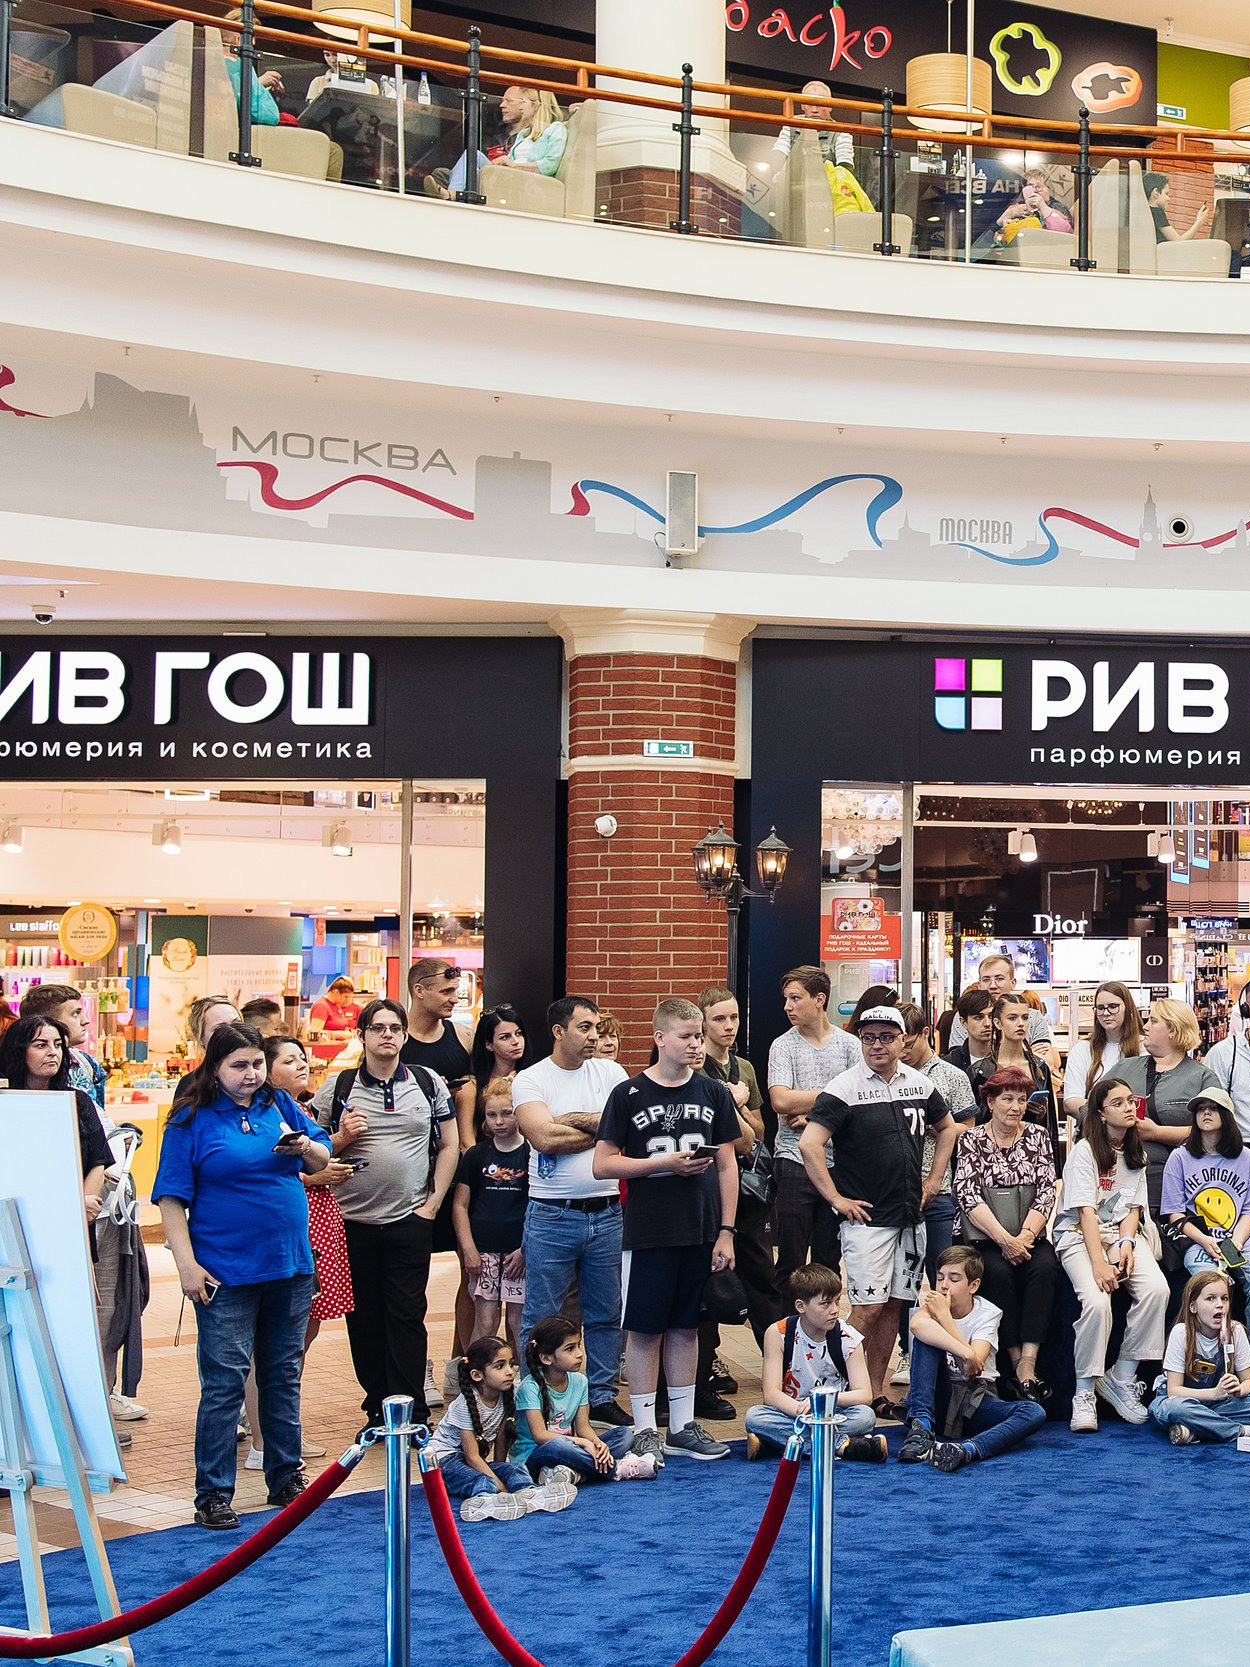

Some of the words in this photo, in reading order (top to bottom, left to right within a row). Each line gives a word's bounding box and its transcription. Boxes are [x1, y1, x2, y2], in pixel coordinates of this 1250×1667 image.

[232, 426, 457, 476] МОСКВА
[939, 517, 1013, 545] МОСКВА
[154, 651, 371, 726] ГОШ
[1031, 659, 1230, 734] РИВ
[160, 742, 175, 757] и
[193, 741, 372, 758] косметика
[1030, 745, 1242, 769] парфюмерия
[1032, 914, 1089, 934] Dior
[858, 1089, 886, 1101] BLACK
[898, 1086, 924, 1097] SQUAD
[631, 1103, 715, 1132] SPURS
[1185, 1174, 1203, 1195] THE
[1202, 1167, 1248, 1198] ORIGINAL
